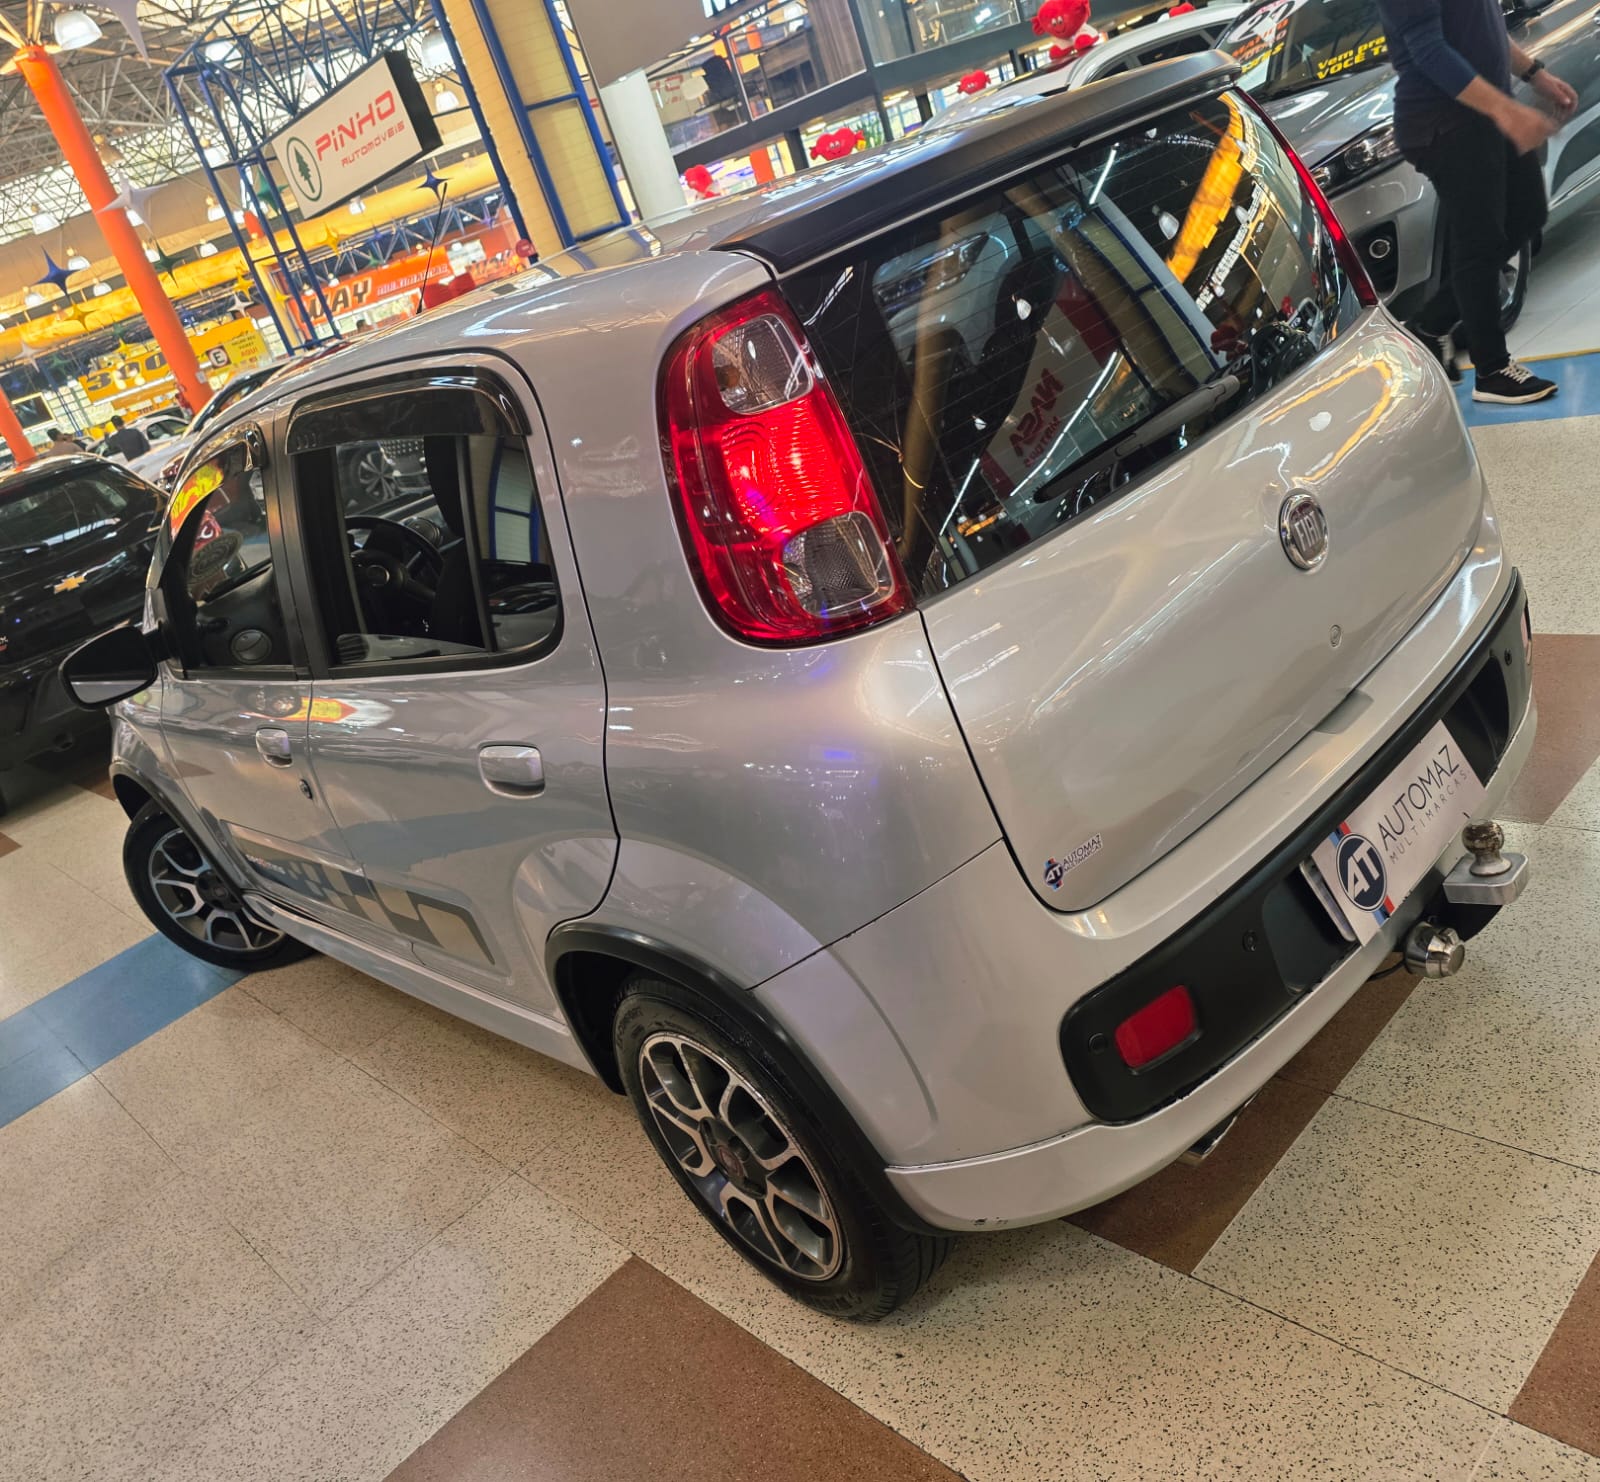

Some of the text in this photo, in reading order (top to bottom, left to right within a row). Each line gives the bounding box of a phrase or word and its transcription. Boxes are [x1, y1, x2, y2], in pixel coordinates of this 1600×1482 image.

[1294, 510, 1321, 552] FIAT
[1377, 744, 1460, 852] AUTOMAZ
[1389, 770, 1469, 865] MULTIMARCAS
[1063, 833, 1101, 867] AUTOMAZ
